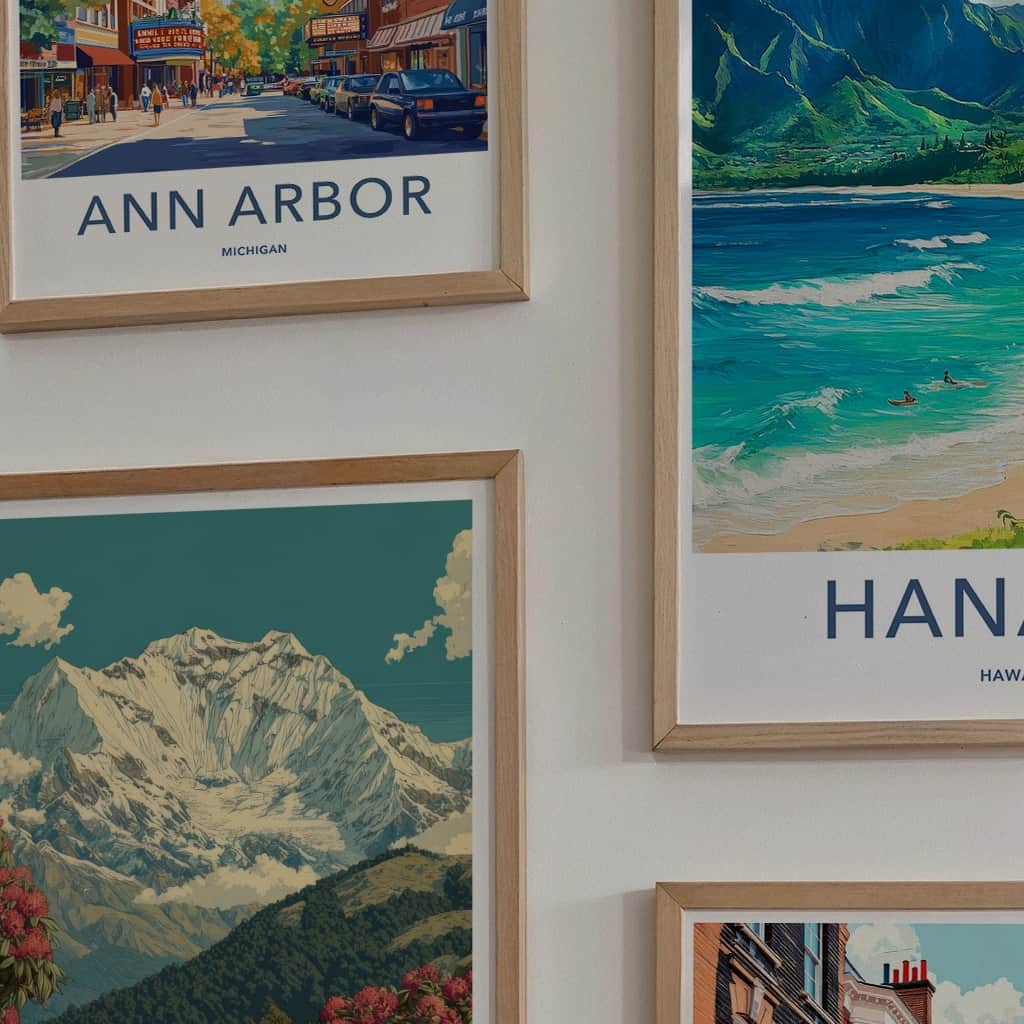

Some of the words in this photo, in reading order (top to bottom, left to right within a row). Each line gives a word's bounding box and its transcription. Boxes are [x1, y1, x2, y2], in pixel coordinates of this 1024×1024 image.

[77, 189, 204, 236] ANN
[229, 175, 432, 227] ARBOR
[221, 244, 287, 257] MICHIGAN
[827, 577, 1024, 640] HAN
[980, 668, 1024, 682] HAW
